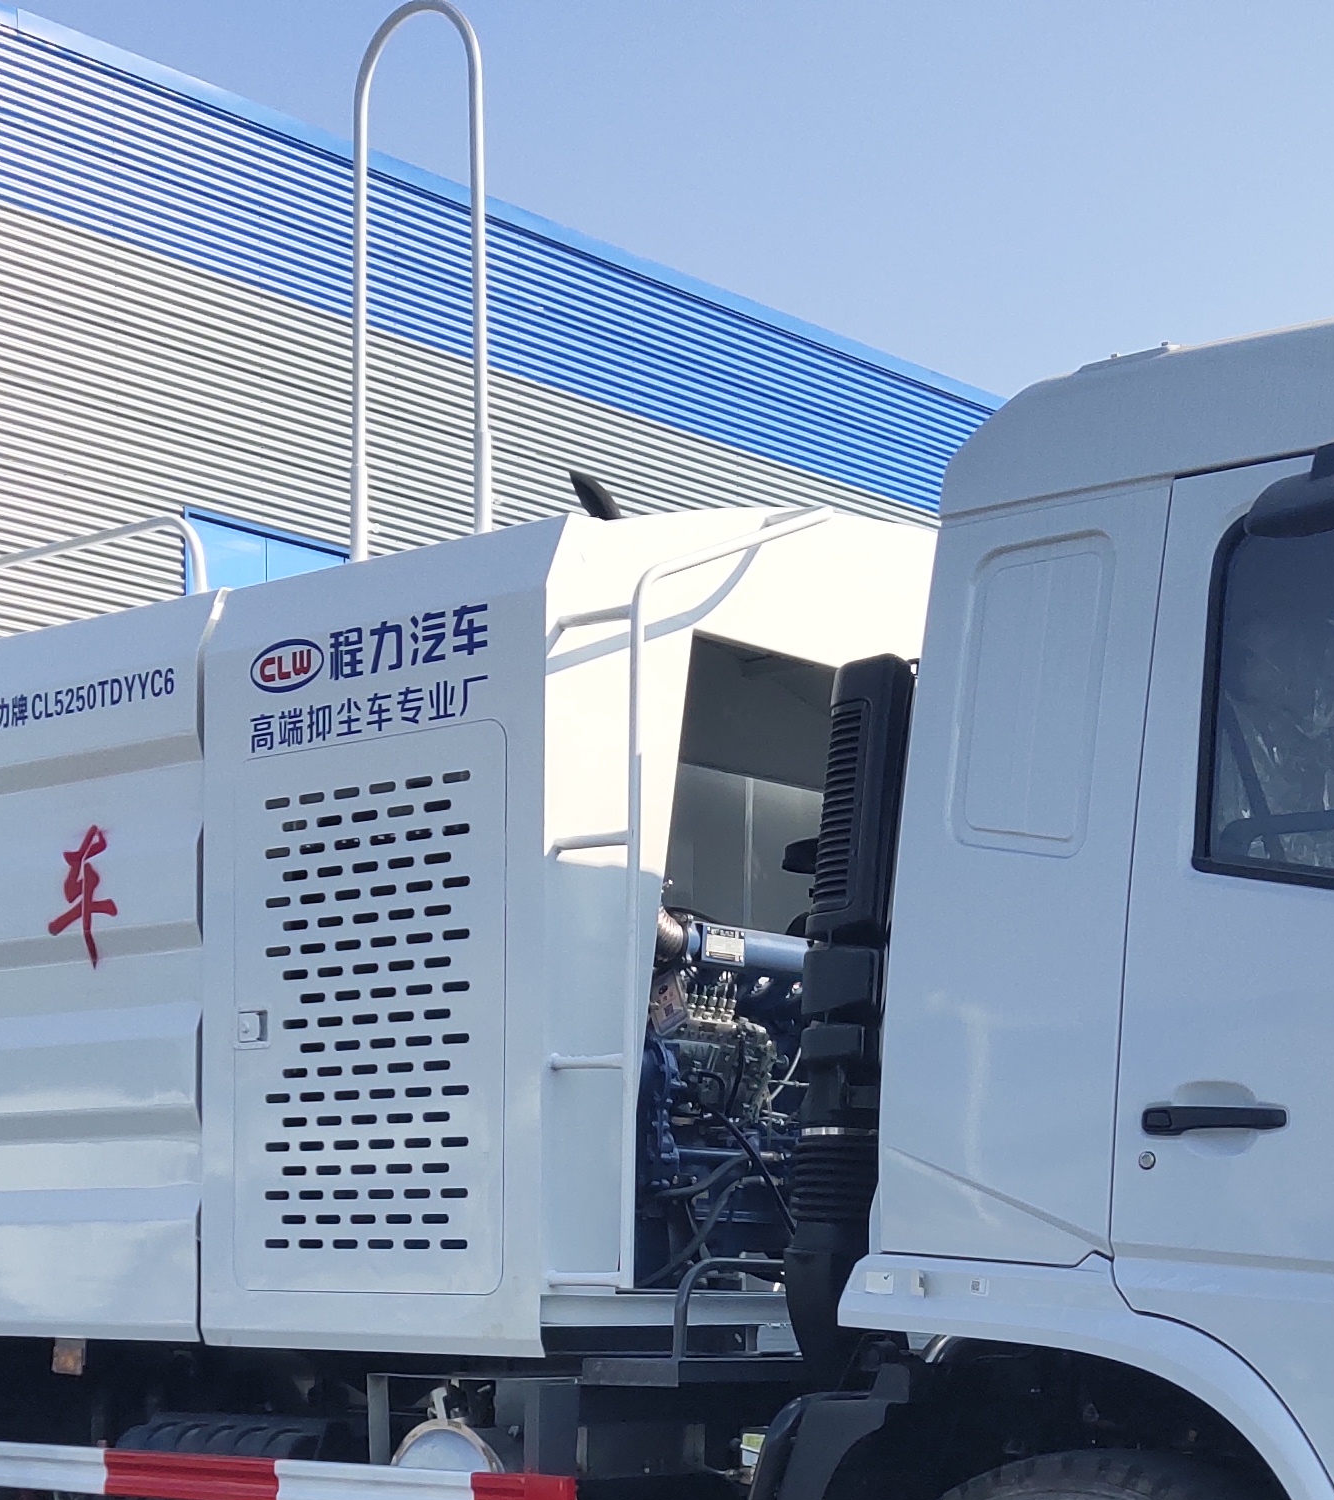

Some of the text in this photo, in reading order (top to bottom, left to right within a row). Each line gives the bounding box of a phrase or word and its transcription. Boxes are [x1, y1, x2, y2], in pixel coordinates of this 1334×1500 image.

[259, 603, 489, 683] CLW 程力汽车
[249, 675, 489, 753] 高端抑尘车专业厂
